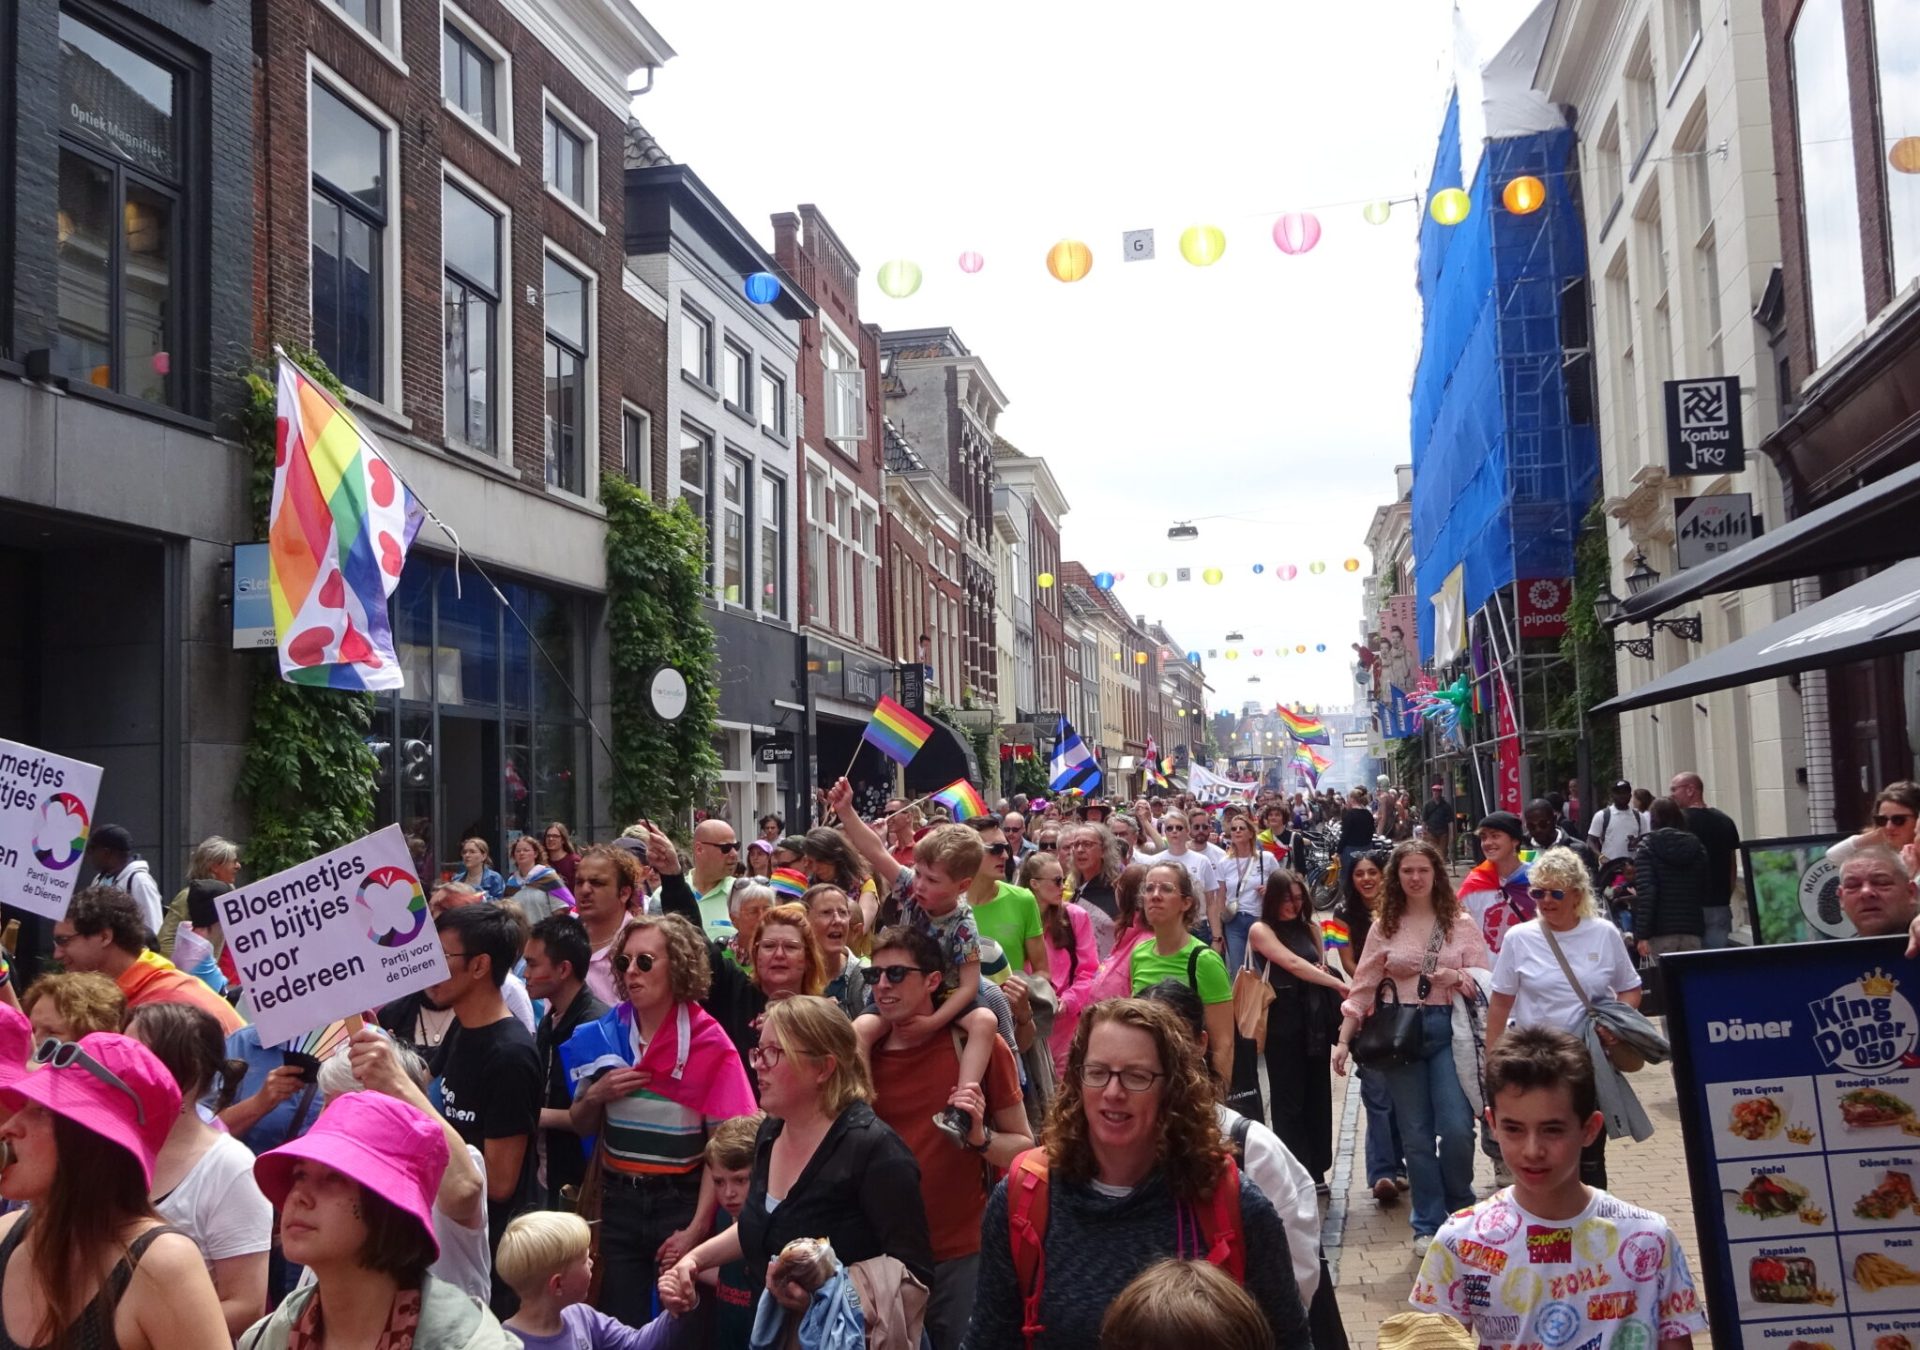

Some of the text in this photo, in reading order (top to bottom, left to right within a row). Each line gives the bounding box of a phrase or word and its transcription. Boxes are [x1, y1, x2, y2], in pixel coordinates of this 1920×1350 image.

[71, 103, 164, 160] Optiek Magnifiek
[1134, 240, 1144, 251] G
[1681, 426, 1729, 442] Konbu
[1681, 511, 1747, 540] Asahi
[26, 867, 69, 889] Partij voor
[223, 855, 366, 926] Bloemetjes
[23, 882, 62, 903] de Dieren
[234, 895, 349, 954] en bijtjes
[242, 946, 300, 982] voor
[381, 941, 434, 969] Partij voor
[386, 958, 436, 983] de Dieren
[250, 955, 366, 1013] iedereen
[1811, 995, 1892, 1030] King
[1707, 1018, 1792, 1043] Döner
[1814, 1021, 1906, 1064] Döner
[1854, 1040, 1896, 1065] 050
[1732, 1085, 1784, 1096] Pita Gyros
[1835, 1076, 1910, 1089] Broodje Döner
[1751, 1165, 1786, 1176] Falafel
[1859, 1157, 1913, 1168] Döner Box
[1759, 1245, 1806, 1258] Kapsalon
[1884, 1239, 1913, 1248] Patat
[1763, 1325, 1834, 1339] Döner Schotel
